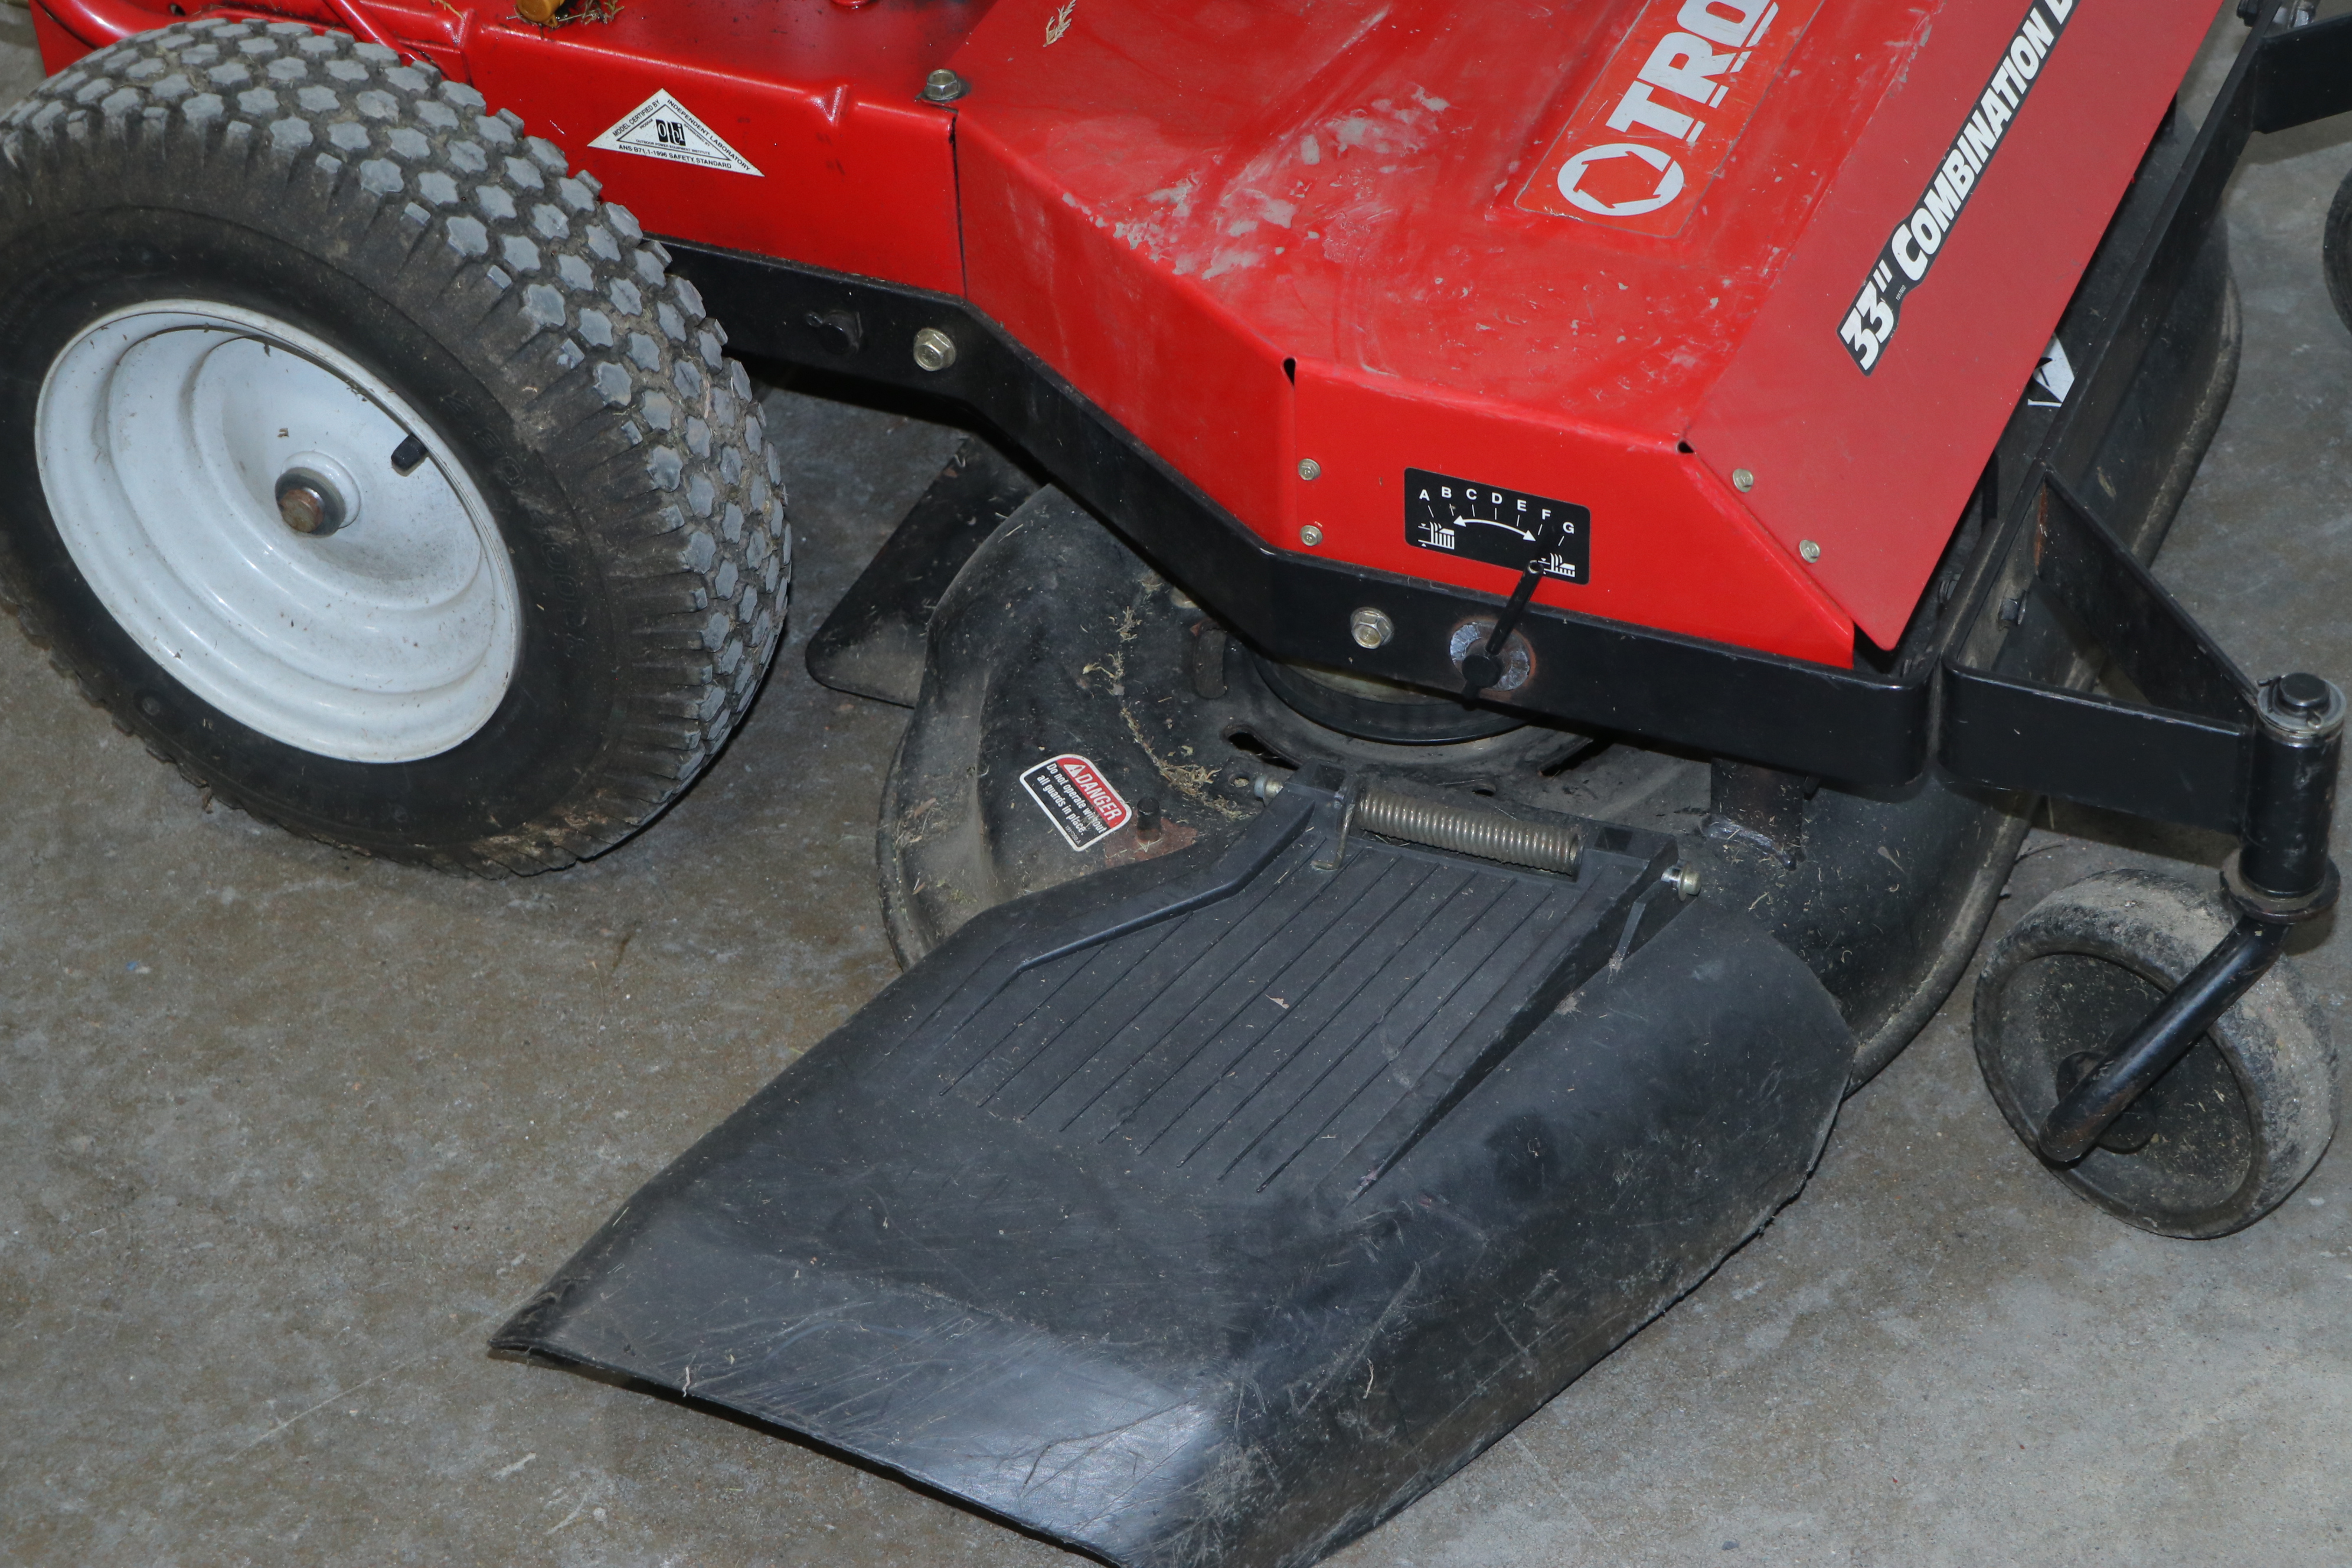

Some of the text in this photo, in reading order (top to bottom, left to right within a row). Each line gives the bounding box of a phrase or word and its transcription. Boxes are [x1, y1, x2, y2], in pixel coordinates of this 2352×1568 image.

[613, 99, 661, 137] MODEL CERTIFIED BY
[639, 118, 653, 129] PROGRAM
[667, 99, 751, 171] INDEPENDENT LABORATORY
[684, 124, 705, 143] SPONSORED
[634, 146, 668, 158] B71.1-1996
[669, 152, 694, 162] SAFETY
[696, 158, 731, 169] STANDARD
[1840, 6, 2054, 371] 33" COMBINATION
[1419, 486, 1574, 534] A B C D E F G
[1037, 775, 1087, 835] all guards in place.
[1046, 763, 1058, 774] Do
[1054, 773, 1069, 786] not
[1063, 783, 1086, 809] operate
[1075, 773, 1122, 821] DANGER
